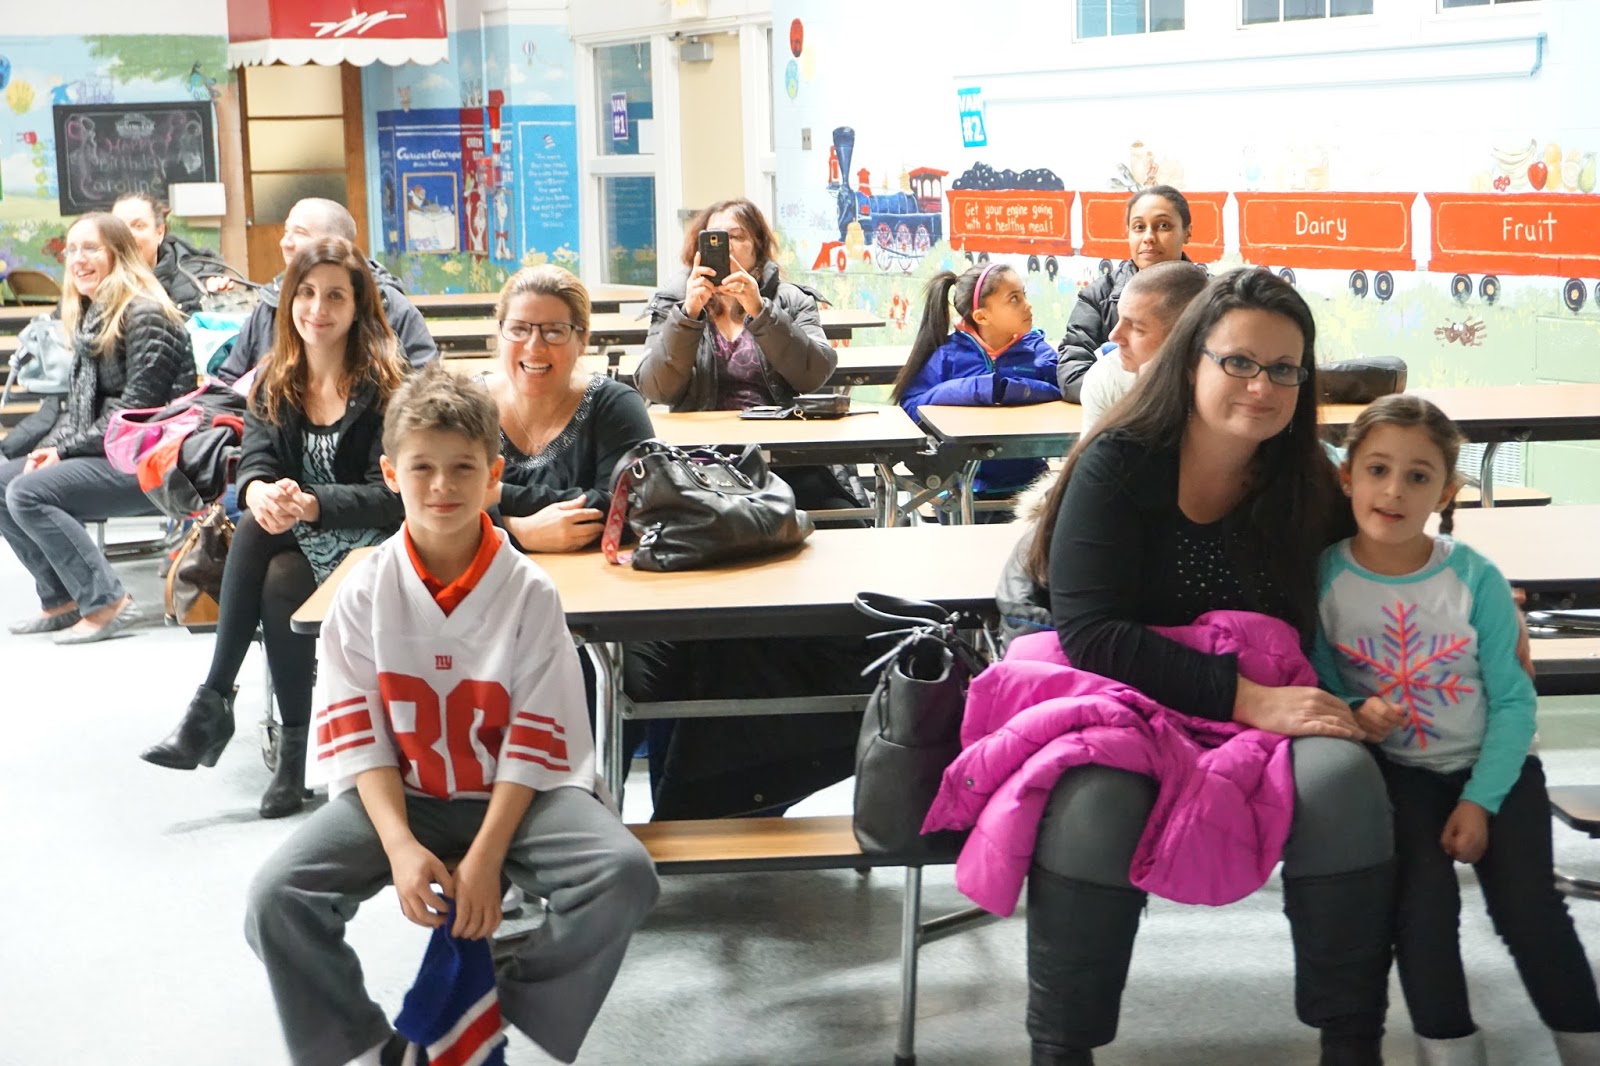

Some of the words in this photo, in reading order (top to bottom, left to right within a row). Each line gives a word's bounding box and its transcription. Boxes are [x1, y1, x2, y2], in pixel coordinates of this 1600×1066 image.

[612, 99, 626, 112] VAN
[958, 93, 982, 112] VAN
[613, 115, 626, 134] #1
[963, 116, 985, 141] #2
[396, 147, 431, 160] Curious
[965, 201, 979, 217] Get
[984, 205, 1003, 219] your
[1006, 204, 1028, 218] engine
[1032, 204, 1053, 220] going
[965, 217, 981, 231] with
[985, 222, 991, 231] a
[995, 217, 1025, 234] healthy
[1028, 220, 1054, 234] meal!
[1295, 211, 1347, 241] Dairy
[1503, 211, 1558, 242] Fruit
